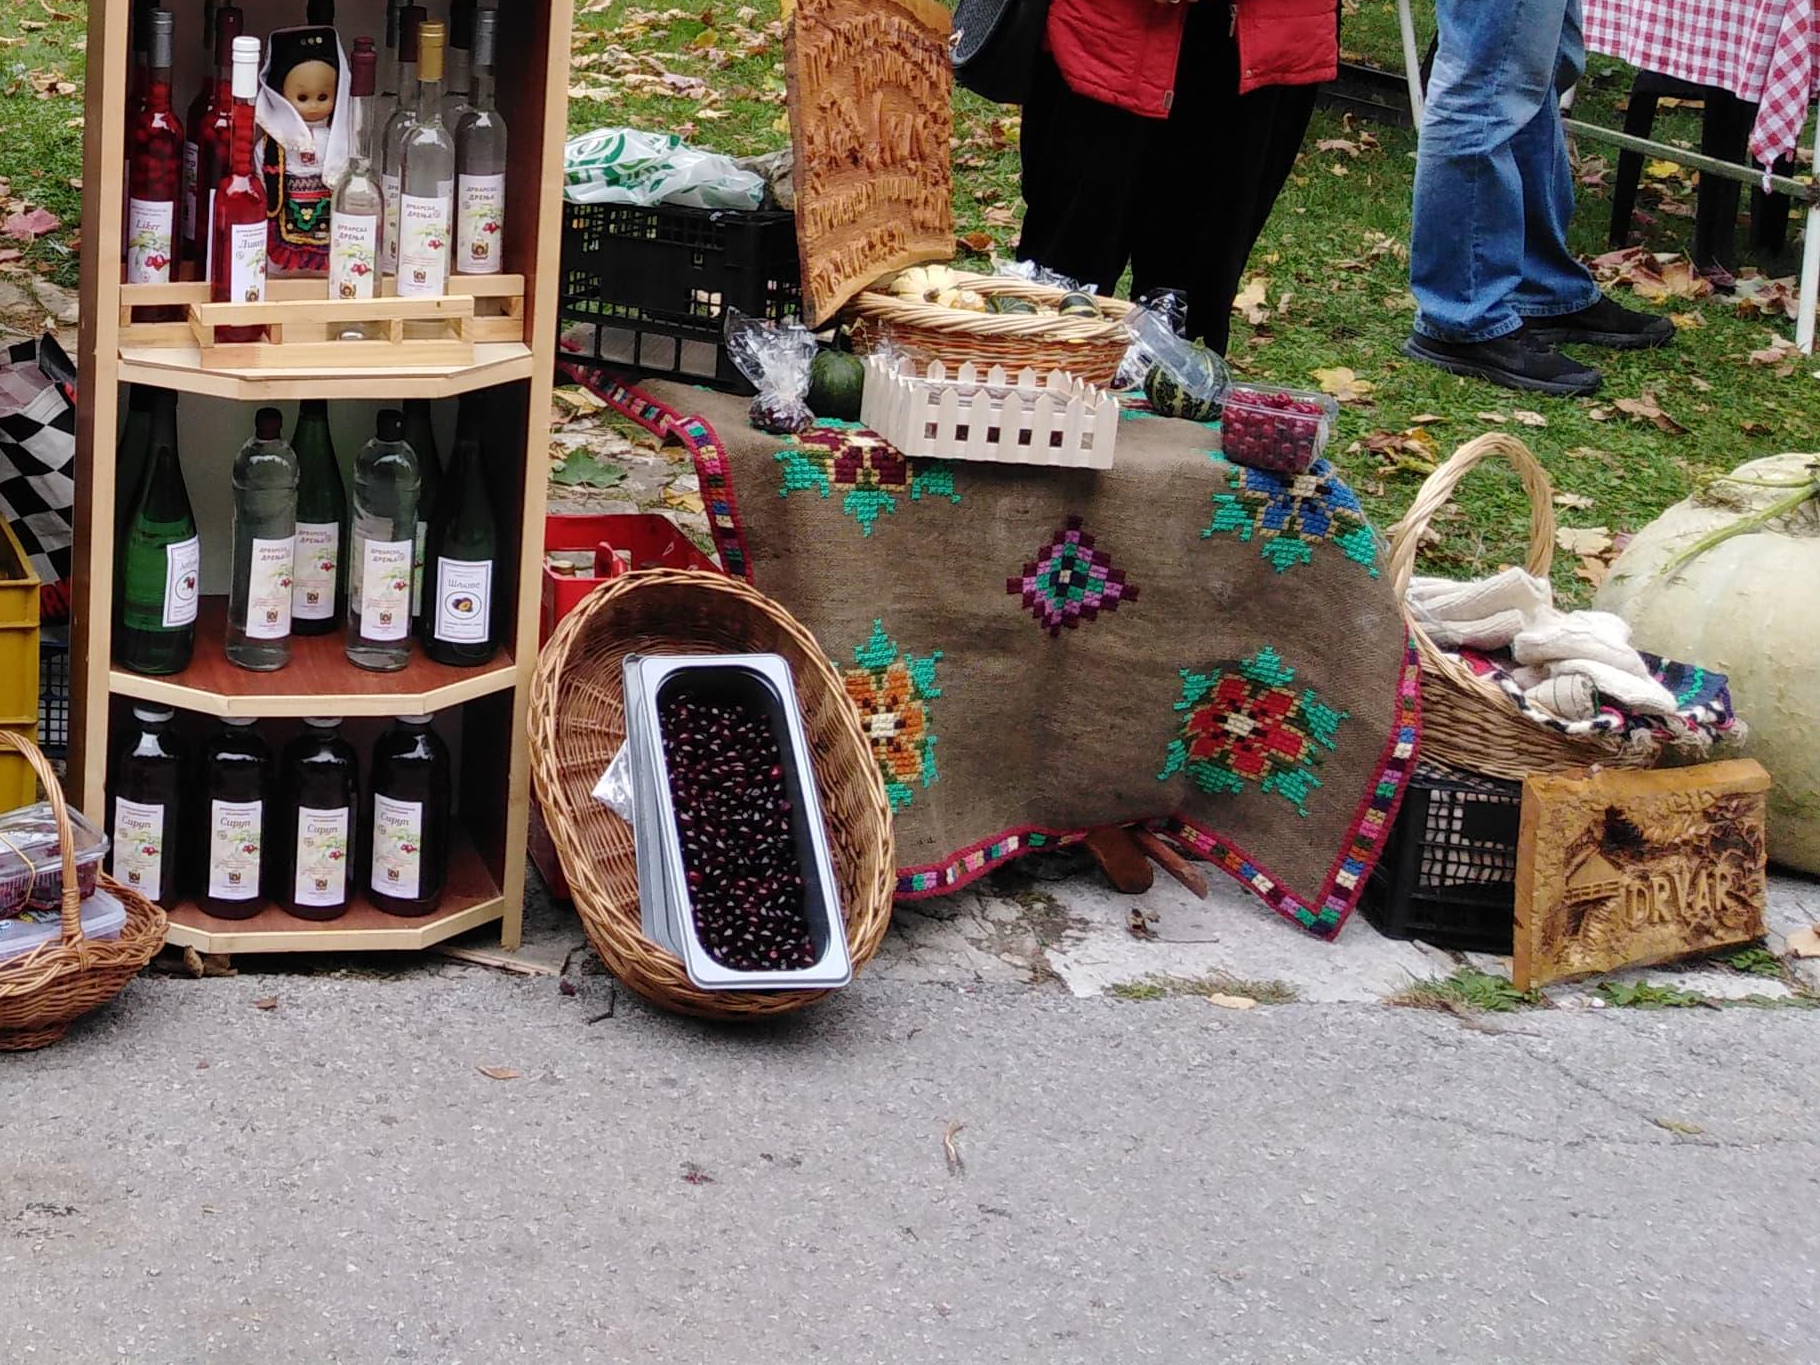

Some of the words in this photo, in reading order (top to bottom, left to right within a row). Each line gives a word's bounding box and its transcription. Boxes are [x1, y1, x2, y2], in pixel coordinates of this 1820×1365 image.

[220, 817, 251, 828] Сируп
[380, 811, 410, 827] Сируп
[307, 823, 338, 836] Сируп
[1621, 863, 1738, 925] DRVAR
